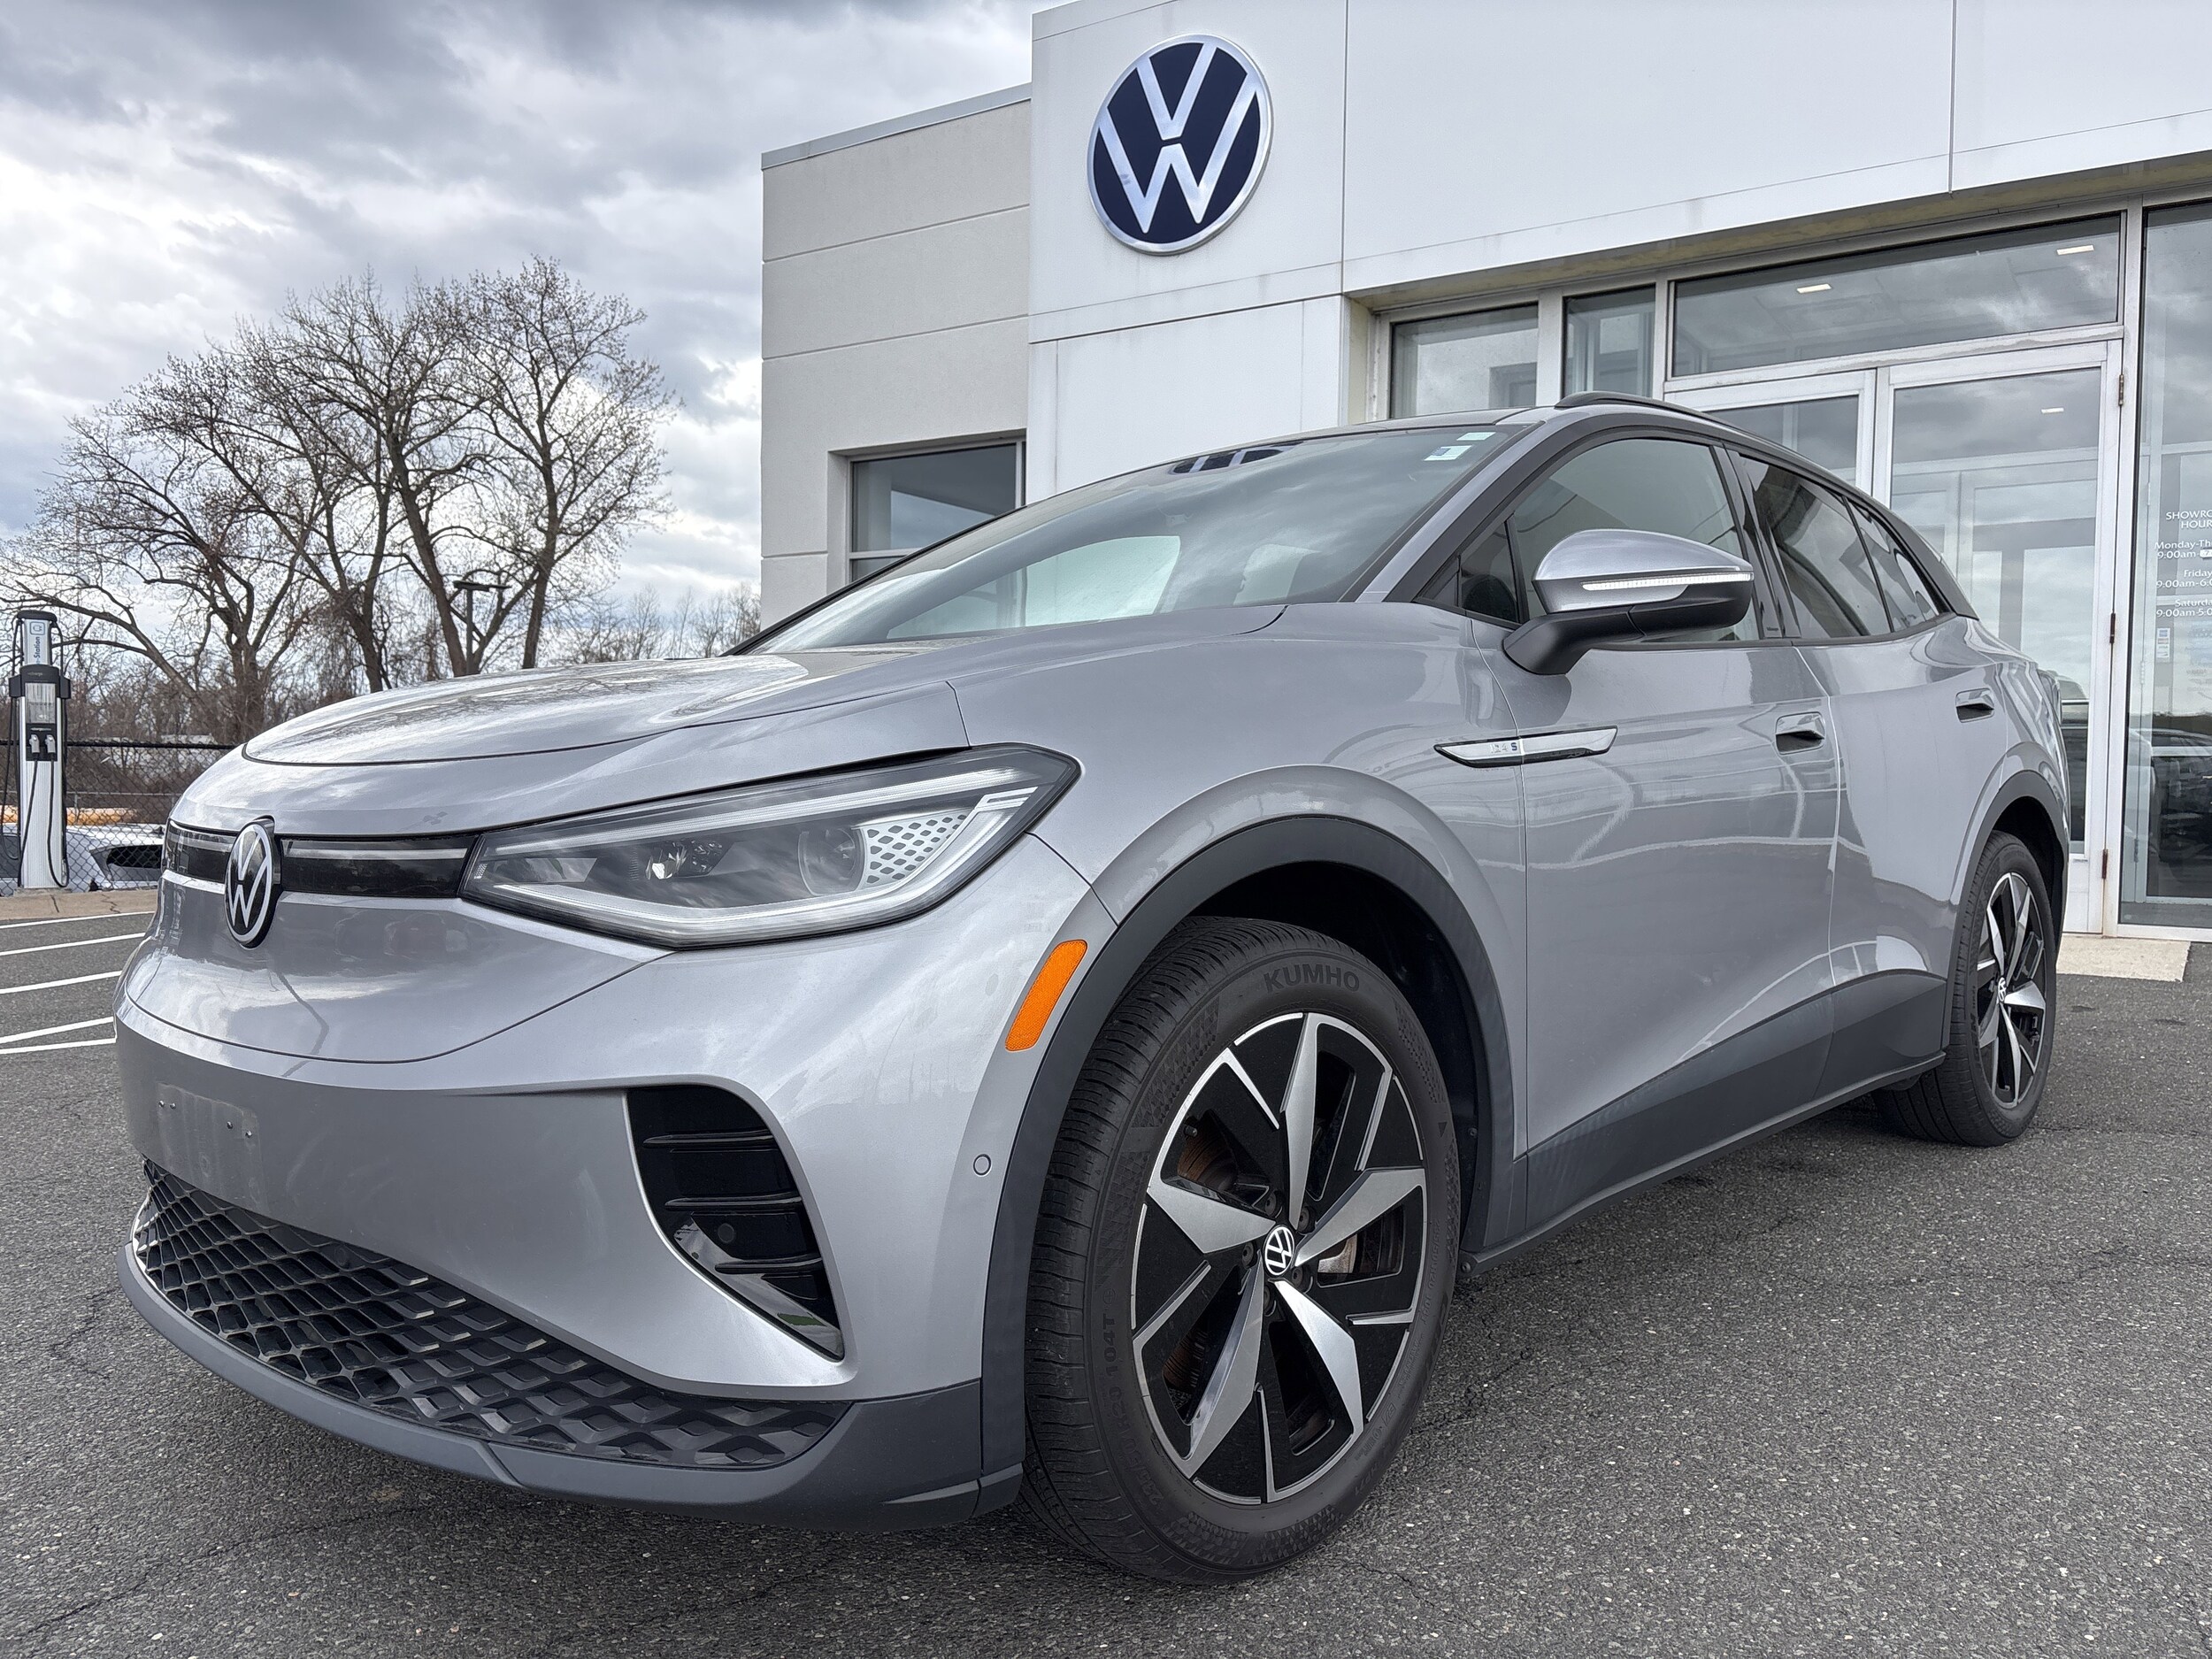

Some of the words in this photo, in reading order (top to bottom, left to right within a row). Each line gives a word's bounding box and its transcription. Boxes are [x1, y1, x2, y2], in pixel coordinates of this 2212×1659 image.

[1093, 39, 1265, 237] VW
[227, 824, 273, 941] VW
[1263, 964, 1360, 992] KUMHO
[1102, 1313, 1118, 1377] 104T
